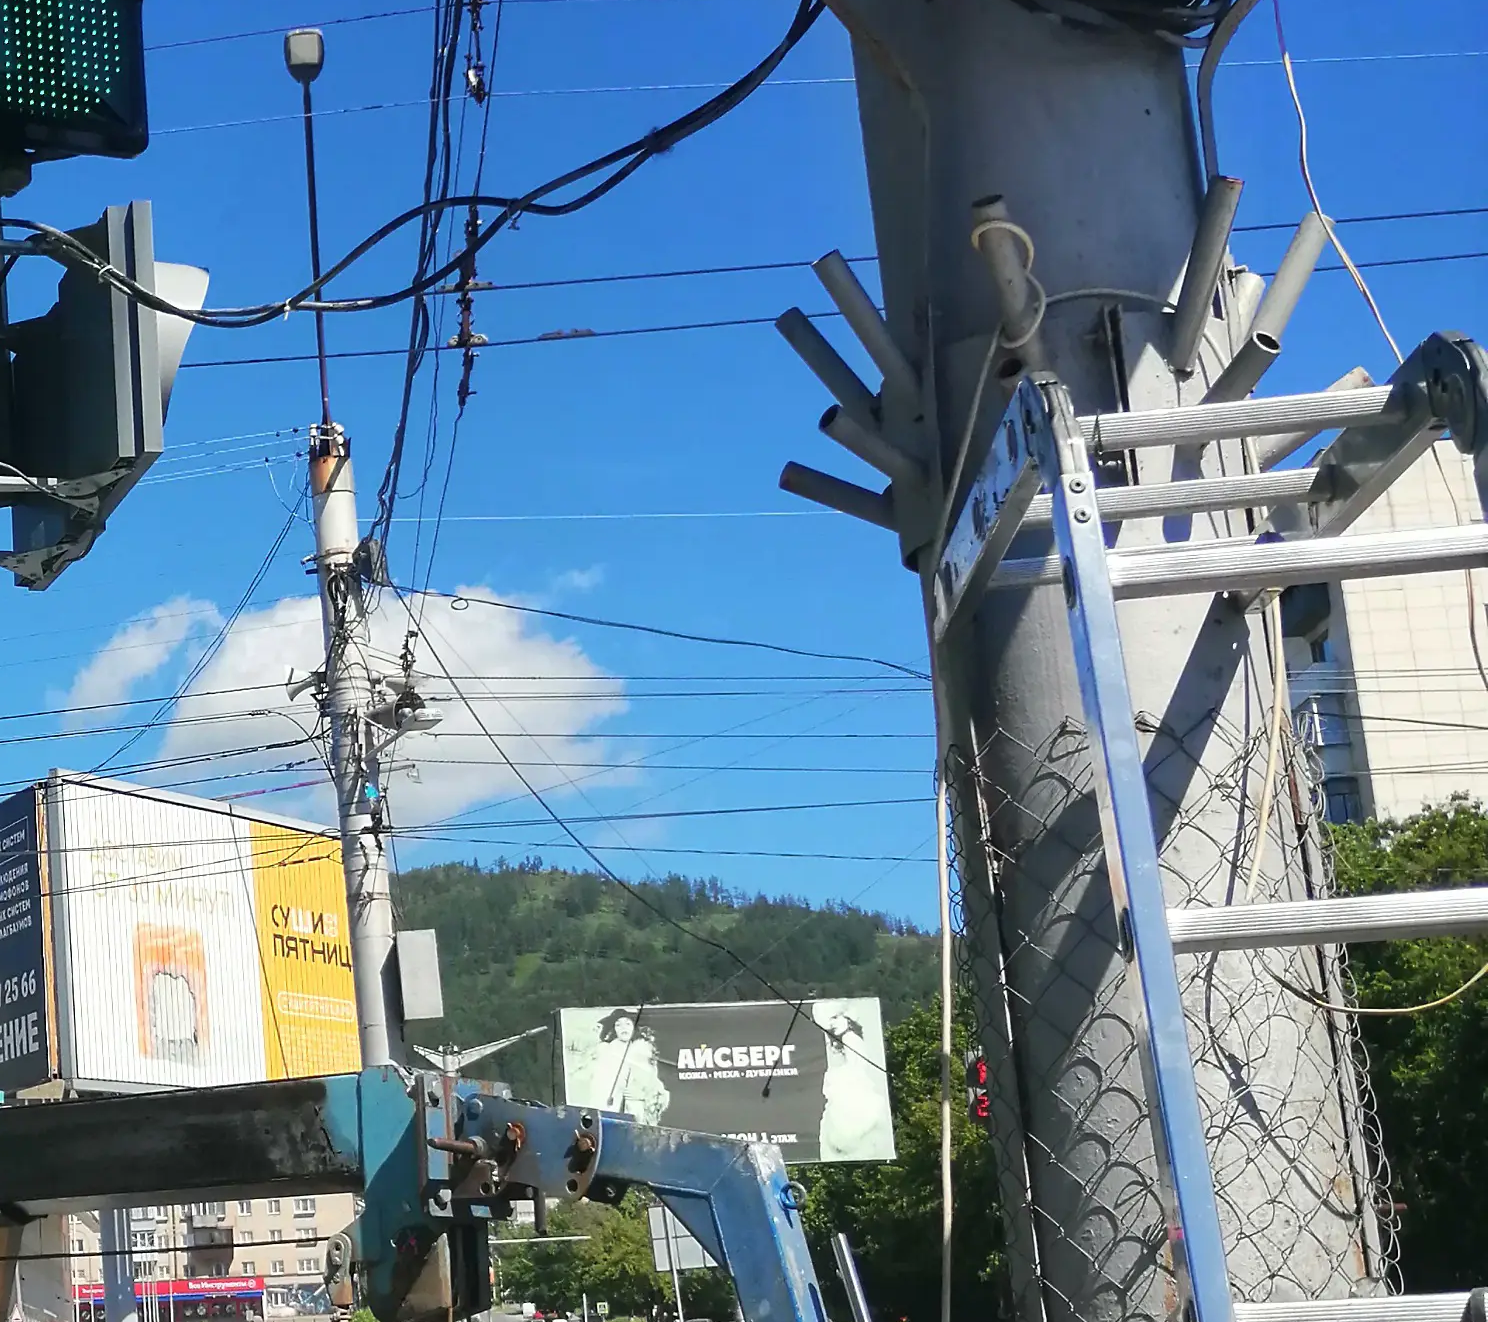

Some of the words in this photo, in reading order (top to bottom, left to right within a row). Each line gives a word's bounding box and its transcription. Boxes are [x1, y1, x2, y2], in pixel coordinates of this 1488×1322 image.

[4, 976, 19, 1005] 25
[20, 969, 37, 998] 66
[677, 1044, 796, 1069] АЙСБЕРГ
